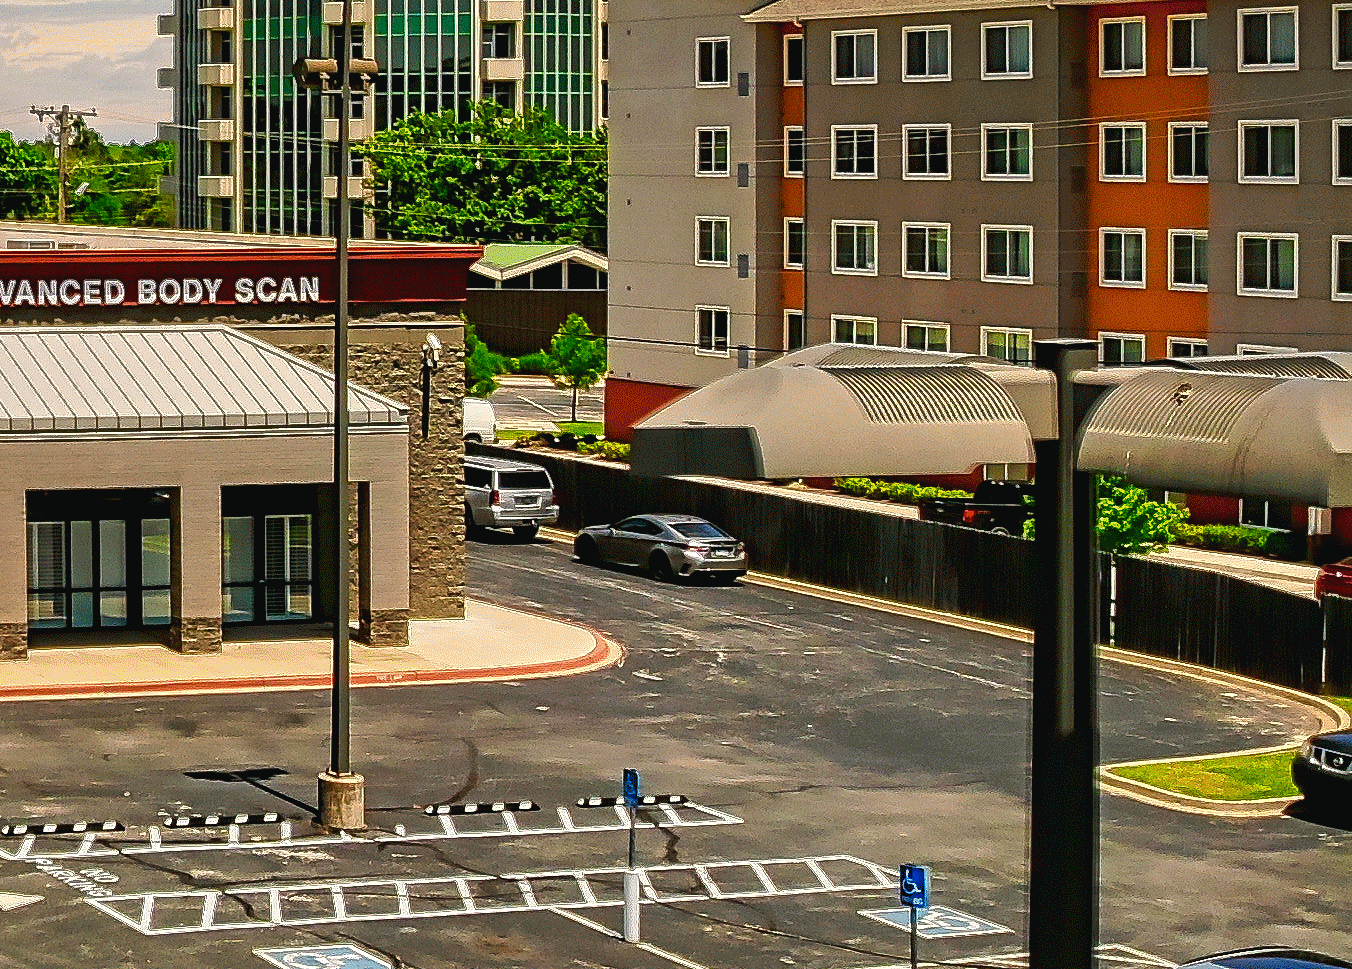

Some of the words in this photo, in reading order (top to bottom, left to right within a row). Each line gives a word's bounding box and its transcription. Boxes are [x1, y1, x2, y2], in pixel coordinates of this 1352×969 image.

[137, 277, 223, 305] BODY
[235, 276, 320, 303] SCAN
[79, 867, 120, 883] NO
